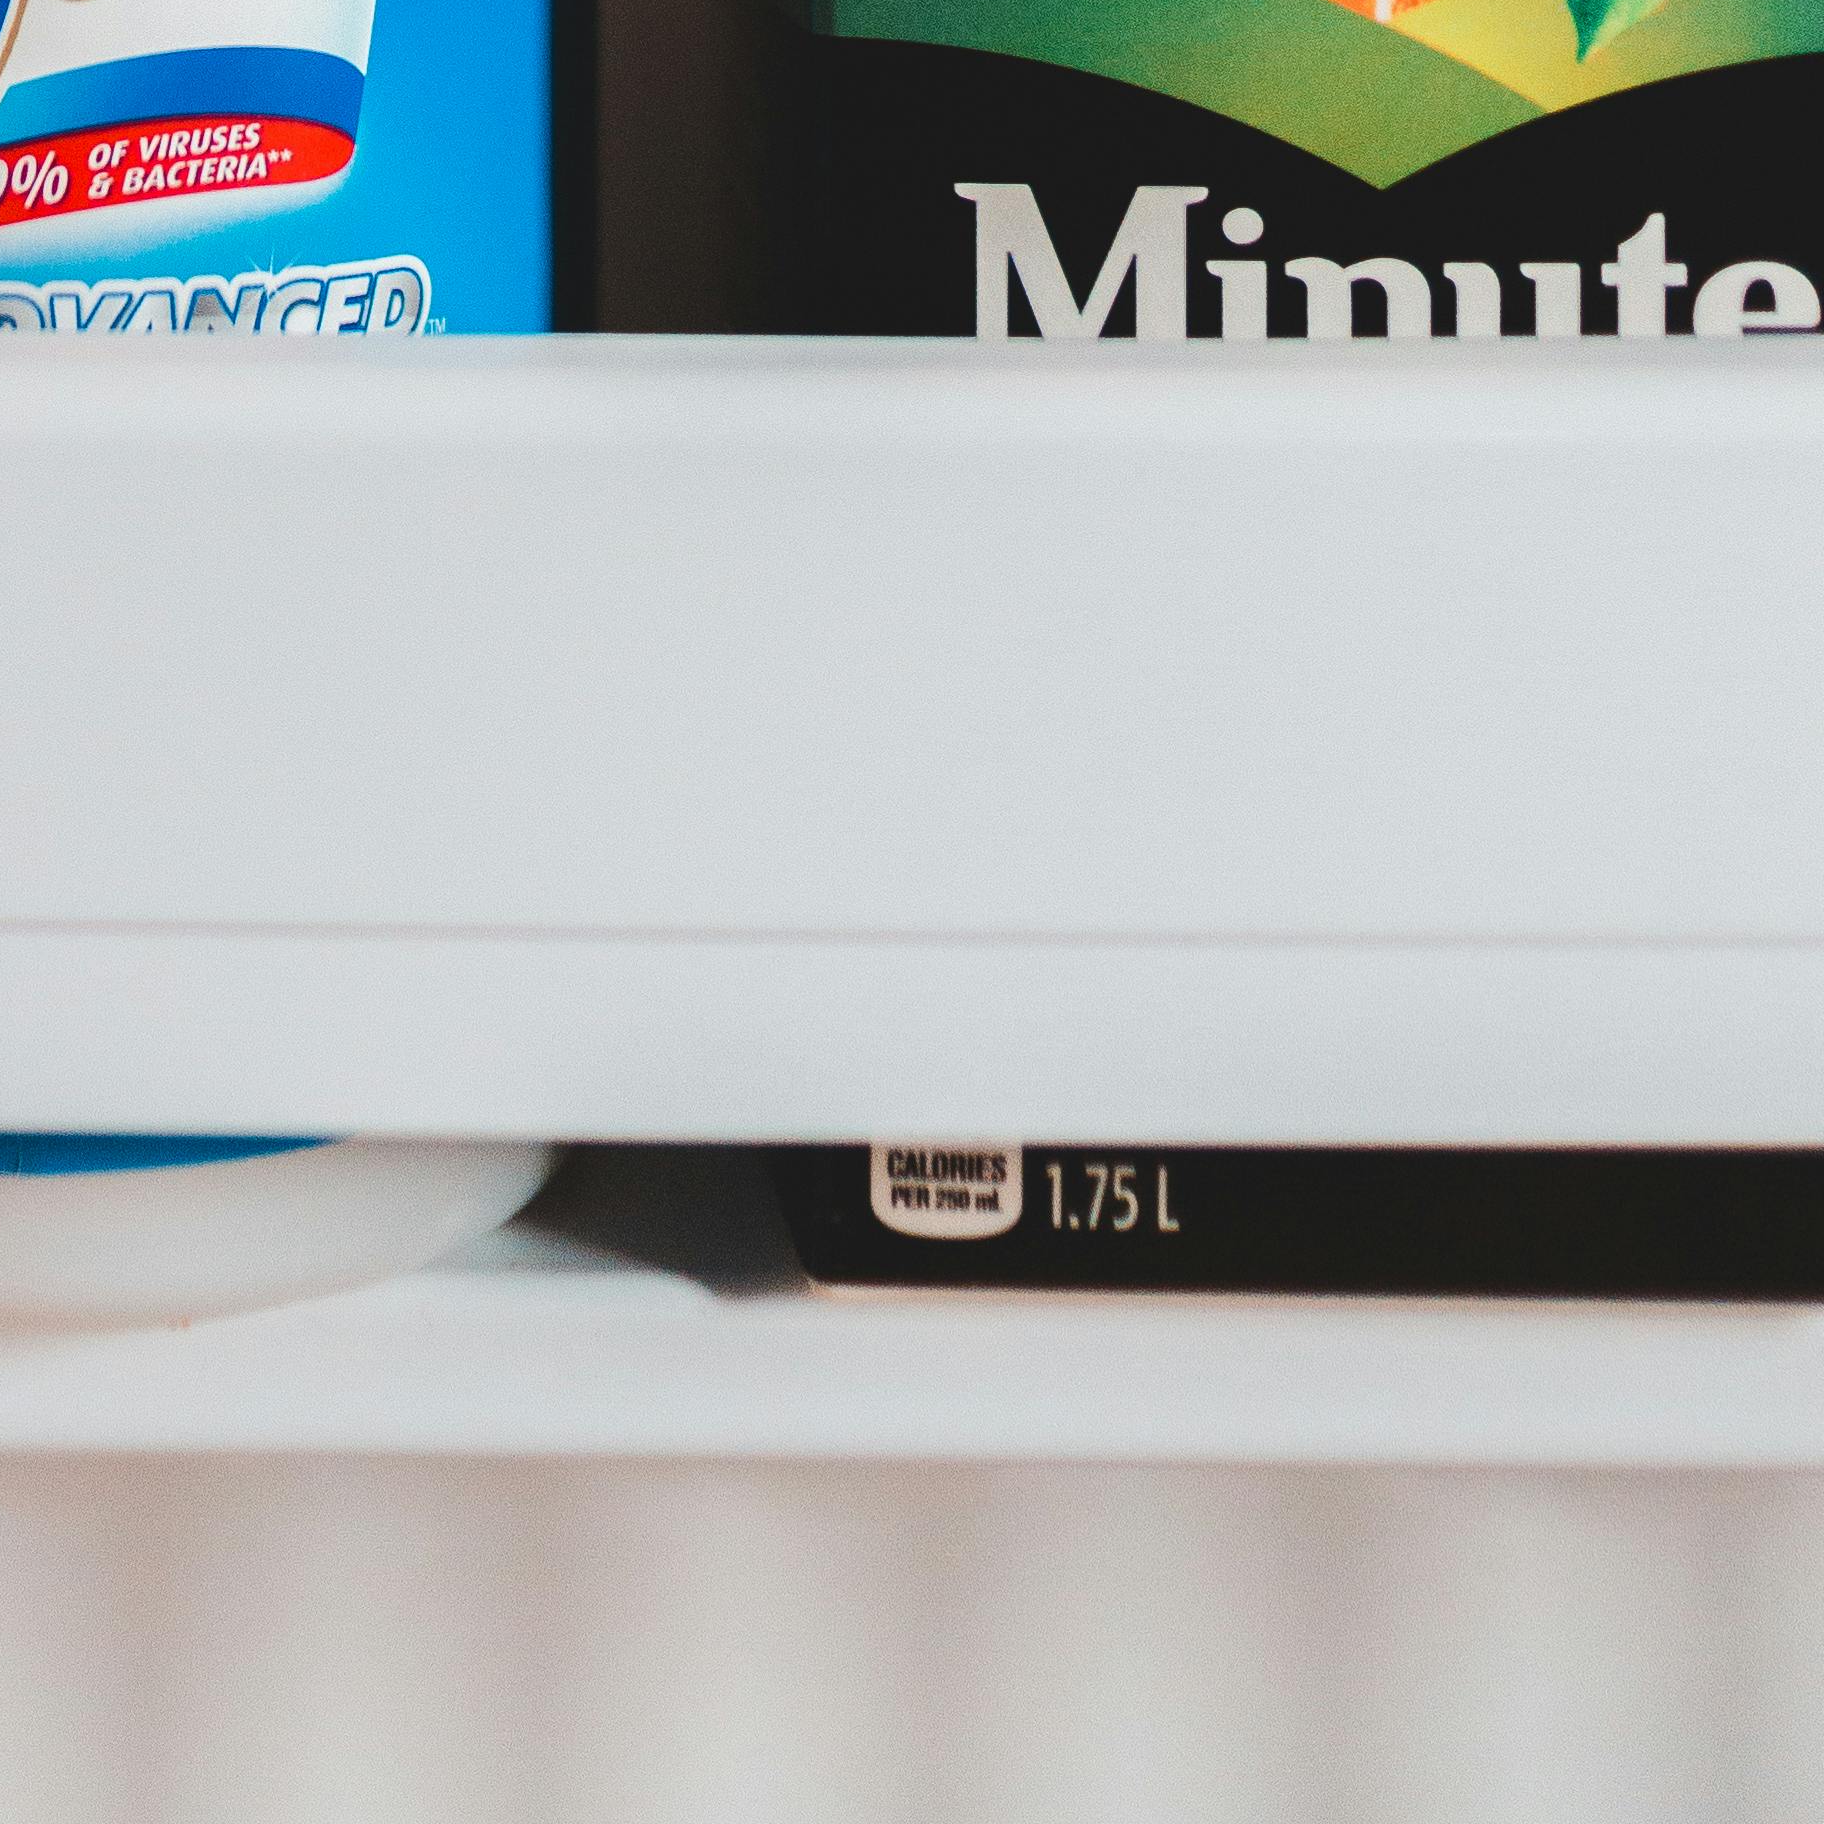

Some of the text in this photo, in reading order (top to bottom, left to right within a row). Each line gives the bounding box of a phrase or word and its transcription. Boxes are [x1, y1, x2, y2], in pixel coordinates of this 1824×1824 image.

[87, 121, 262, 171] OF VIRUSES
[87, 174, 117, 201] &
[953, 182, 1824, 339] Minute
[887, 1150, 1007, 1182] CALORIES
[890, 1185, 931, 1211] PER
[1045, 1162, 1180, 1232] 1.75 L
